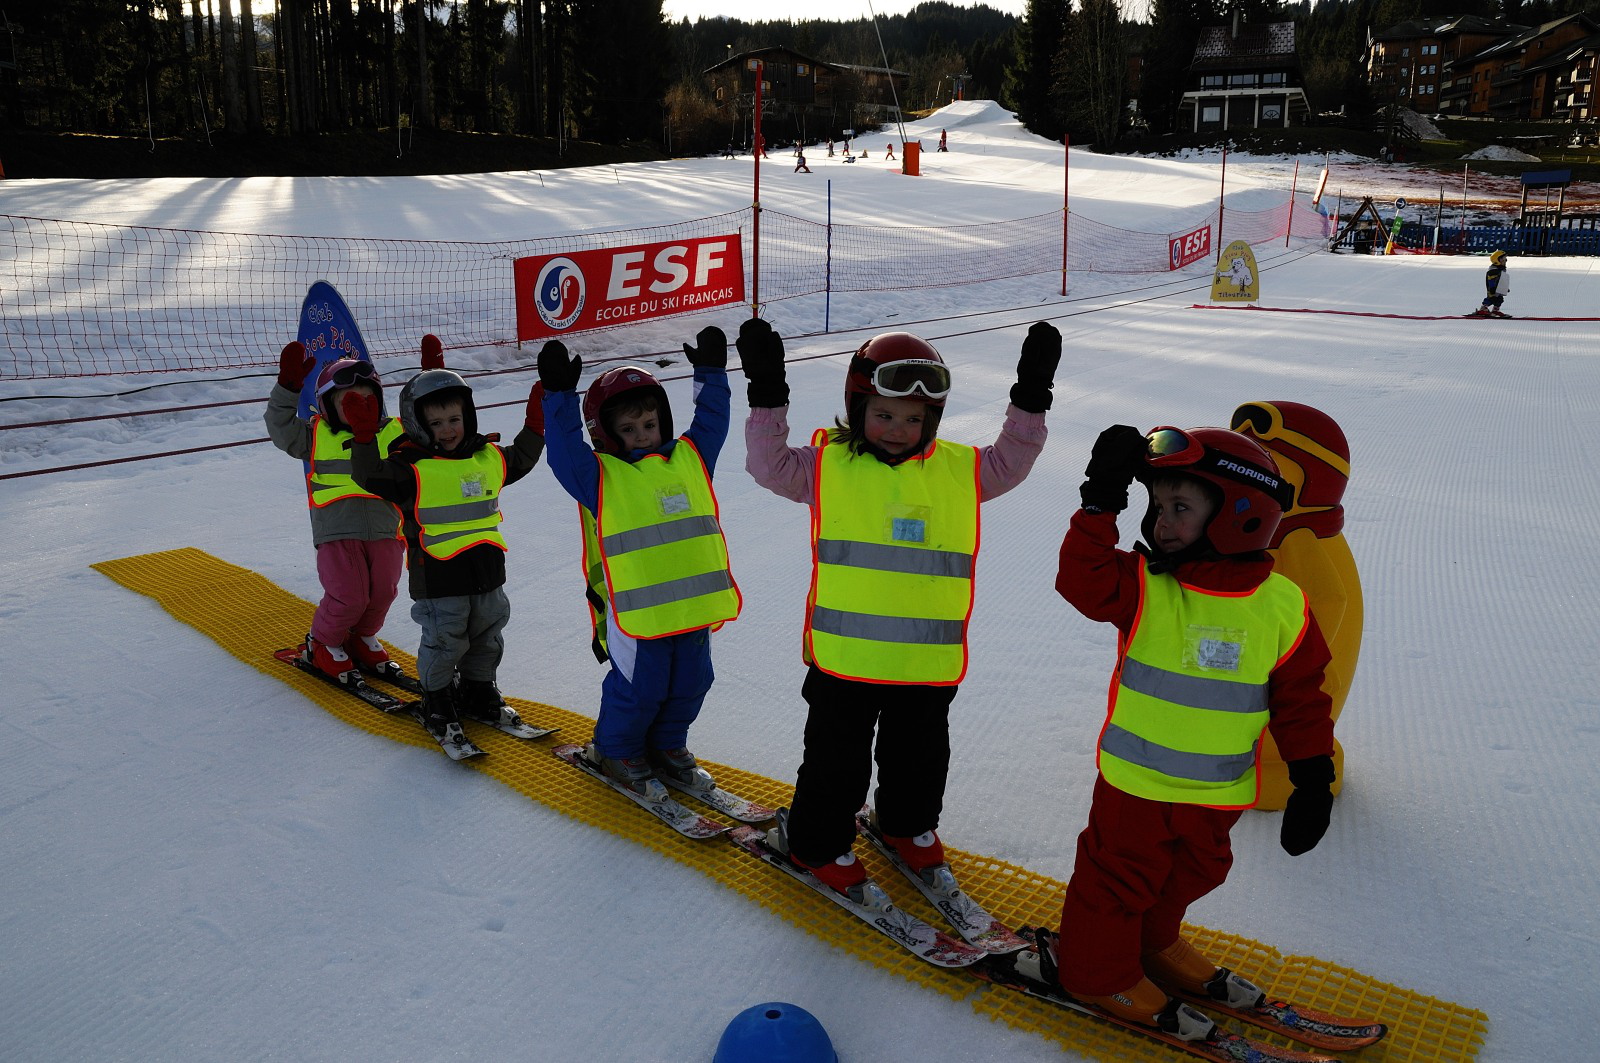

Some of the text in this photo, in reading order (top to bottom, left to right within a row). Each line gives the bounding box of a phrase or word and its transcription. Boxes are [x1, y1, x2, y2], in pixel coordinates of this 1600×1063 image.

[1184, 229, 1208, 256] ESF
[606, 241, 728, 301] ESF
[308, 302, 334, 325] Club
[596, 287, 734, 321] ECOLE DU SKI FRANÇAIS
[1217, 458, 1280, 490] PRORIDER
